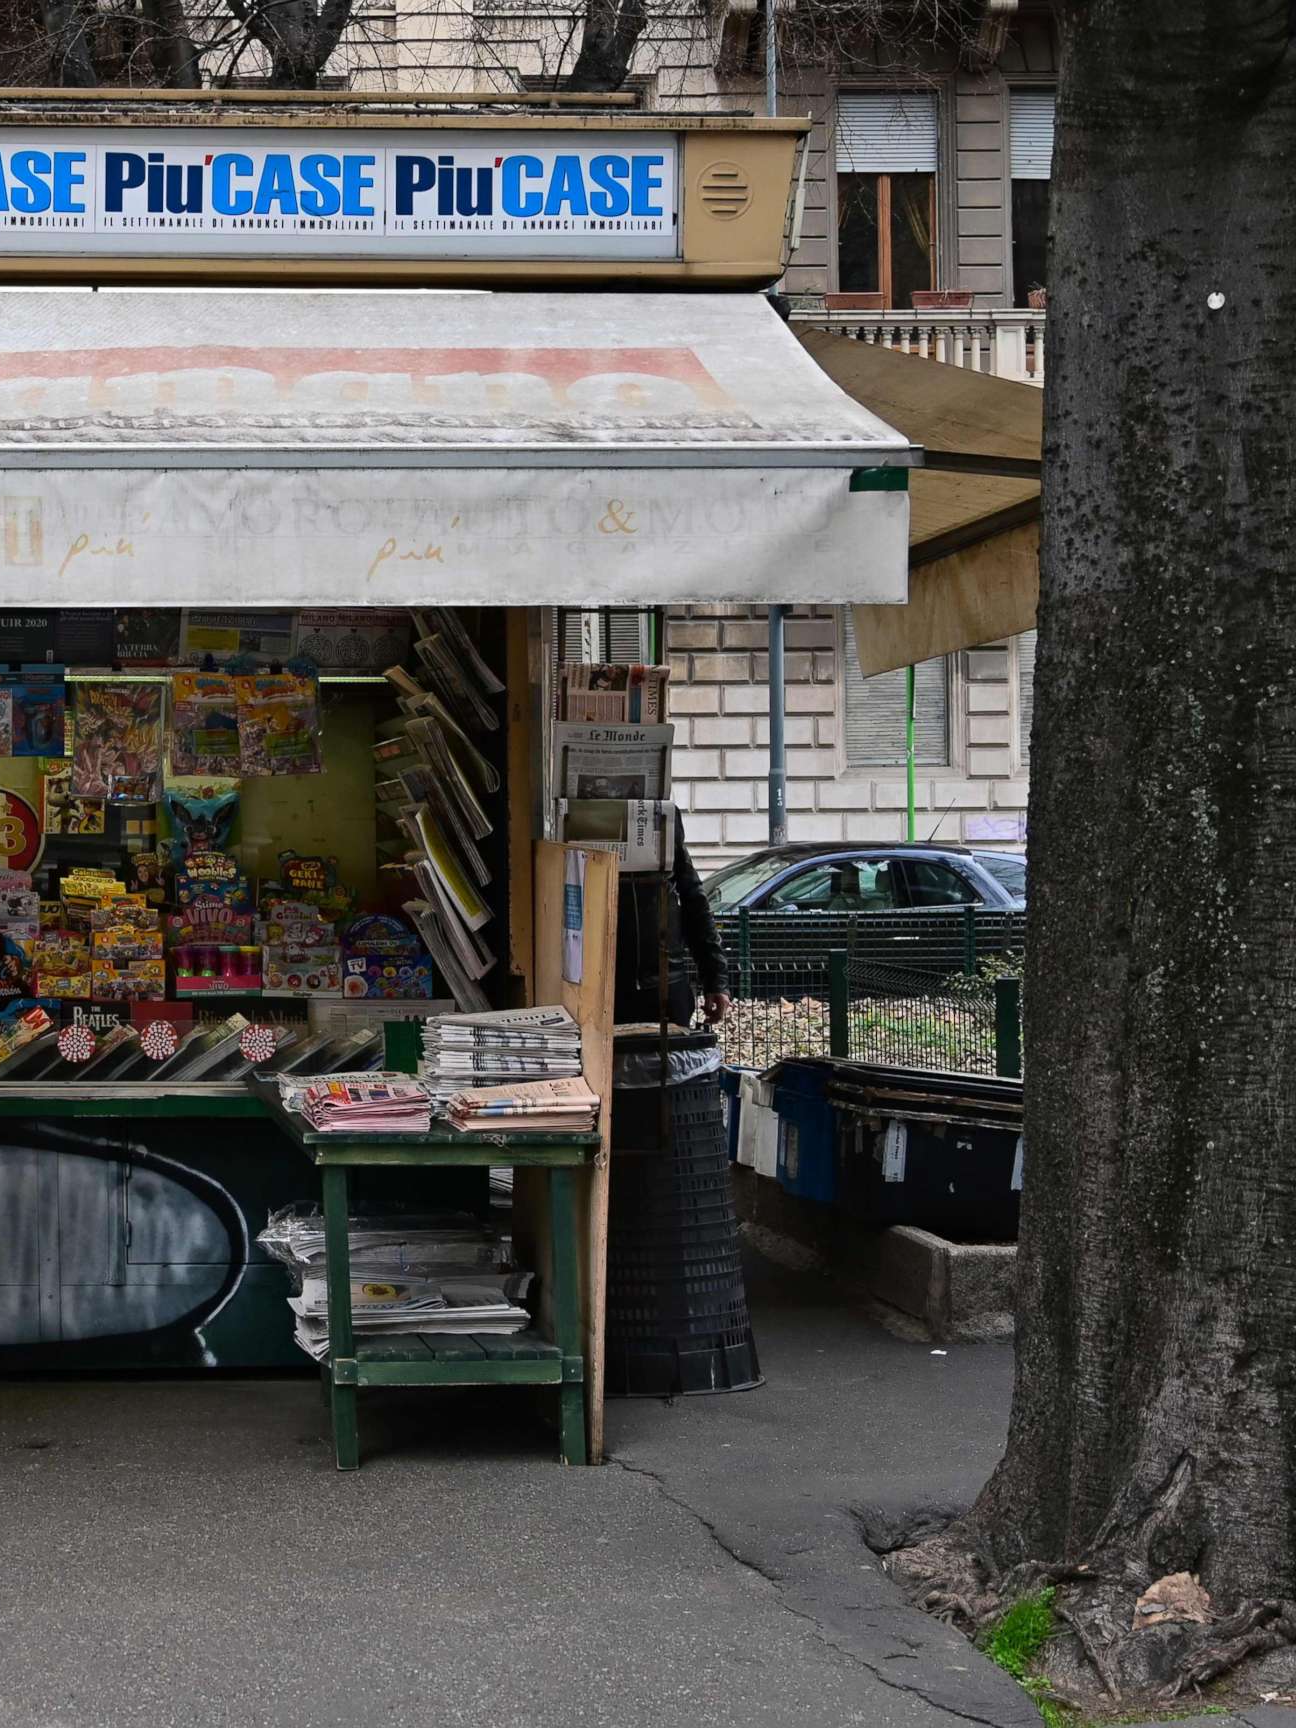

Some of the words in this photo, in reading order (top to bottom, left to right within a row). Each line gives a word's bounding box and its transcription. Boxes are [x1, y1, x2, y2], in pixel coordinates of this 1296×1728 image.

[4, 216, 85, 228] IMMOBILIARI
[104, 217, 113, 227] IL
[123, 217, 203, 228] SETTIMANALE
[212, 218, 223, 229] DI
[232, 219, 284, 229] ANNUNCI
[294, 219, 374, 230] IMMOBILIARI
[395, 220, 404, 230] IL
[413, 220, 494, 230] SETTIMANALE
[502, 220, 514, 230] DI
[523, 220, 575, 230] ANNUNCI
[584, 220, 663, 231] IMMOBILIARI
[597, 498, 639, 534] &
[23, 618, 48, 628] 2020
[589, 729, 602, 742] Le
[603, 729, 647, 742] Monde
[184, 909, 233, 925] VIVO
[350, 960, 364, 970] TV
[72, 1006, 120, 1031] BEATLES
